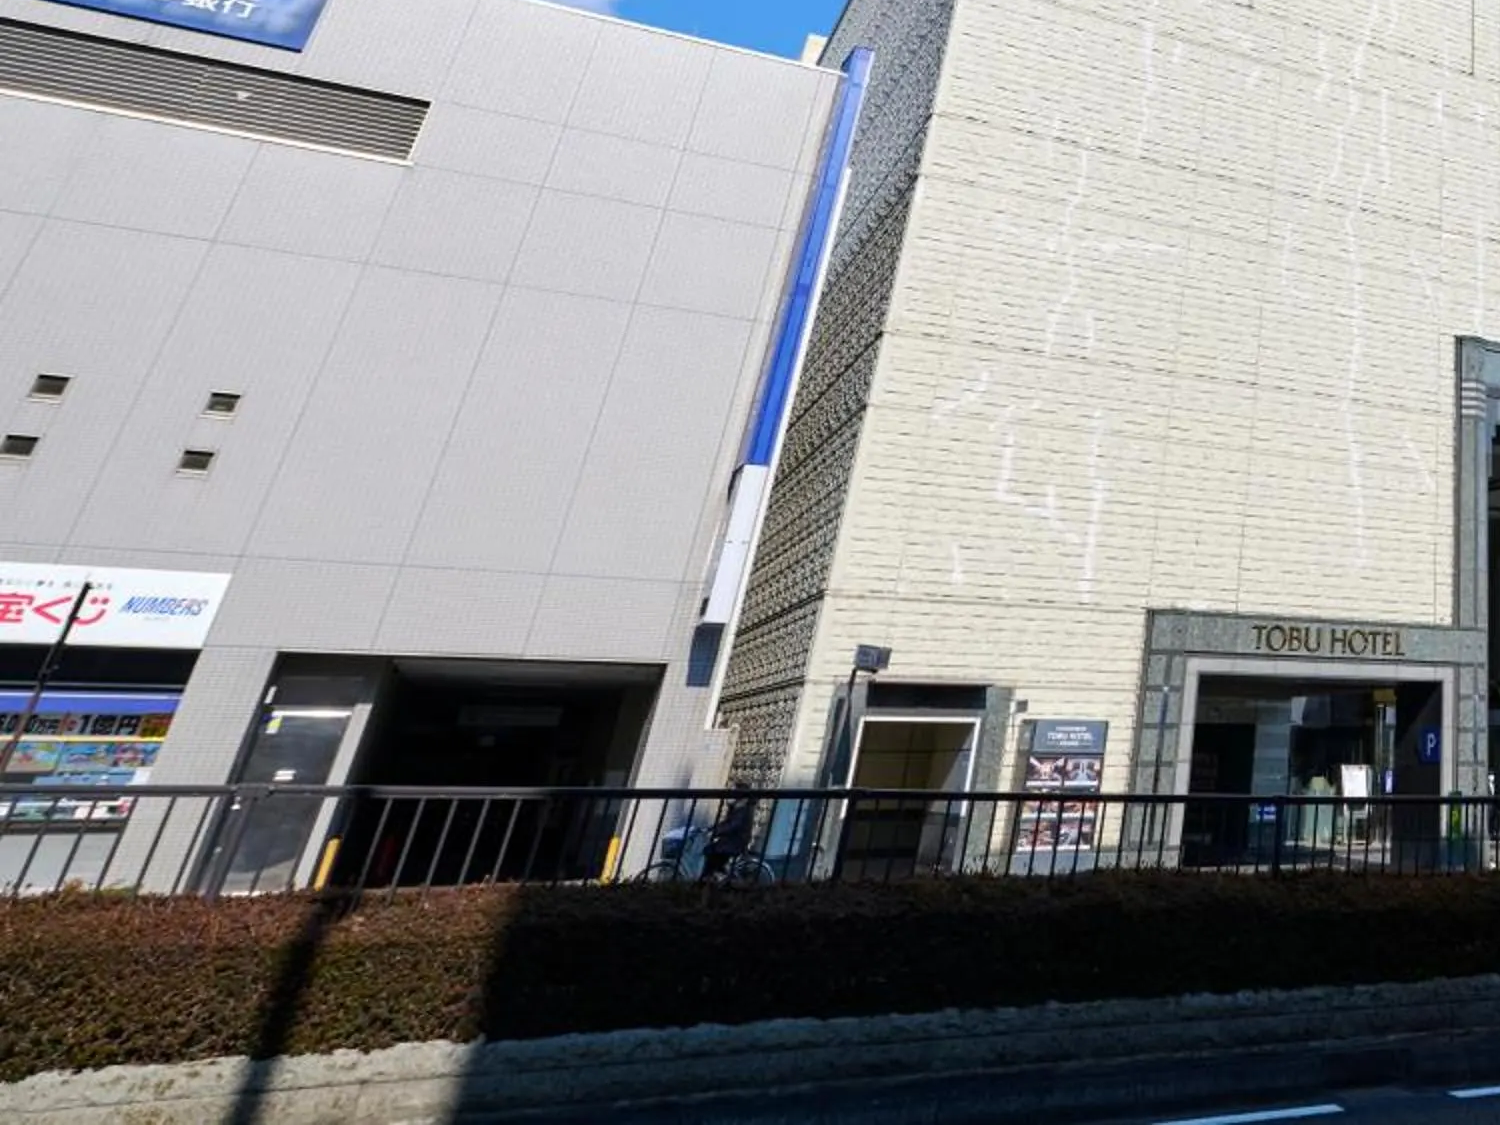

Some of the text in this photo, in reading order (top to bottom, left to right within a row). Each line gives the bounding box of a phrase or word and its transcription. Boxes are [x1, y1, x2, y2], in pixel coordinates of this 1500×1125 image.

[0, 592, 110, 626] 宝くじ
[119, 595, 209, 617] NUMBERS
[1252, 624, 1406, 657] TOBU HOTEL
[1426, 732, 1437, 757] P
